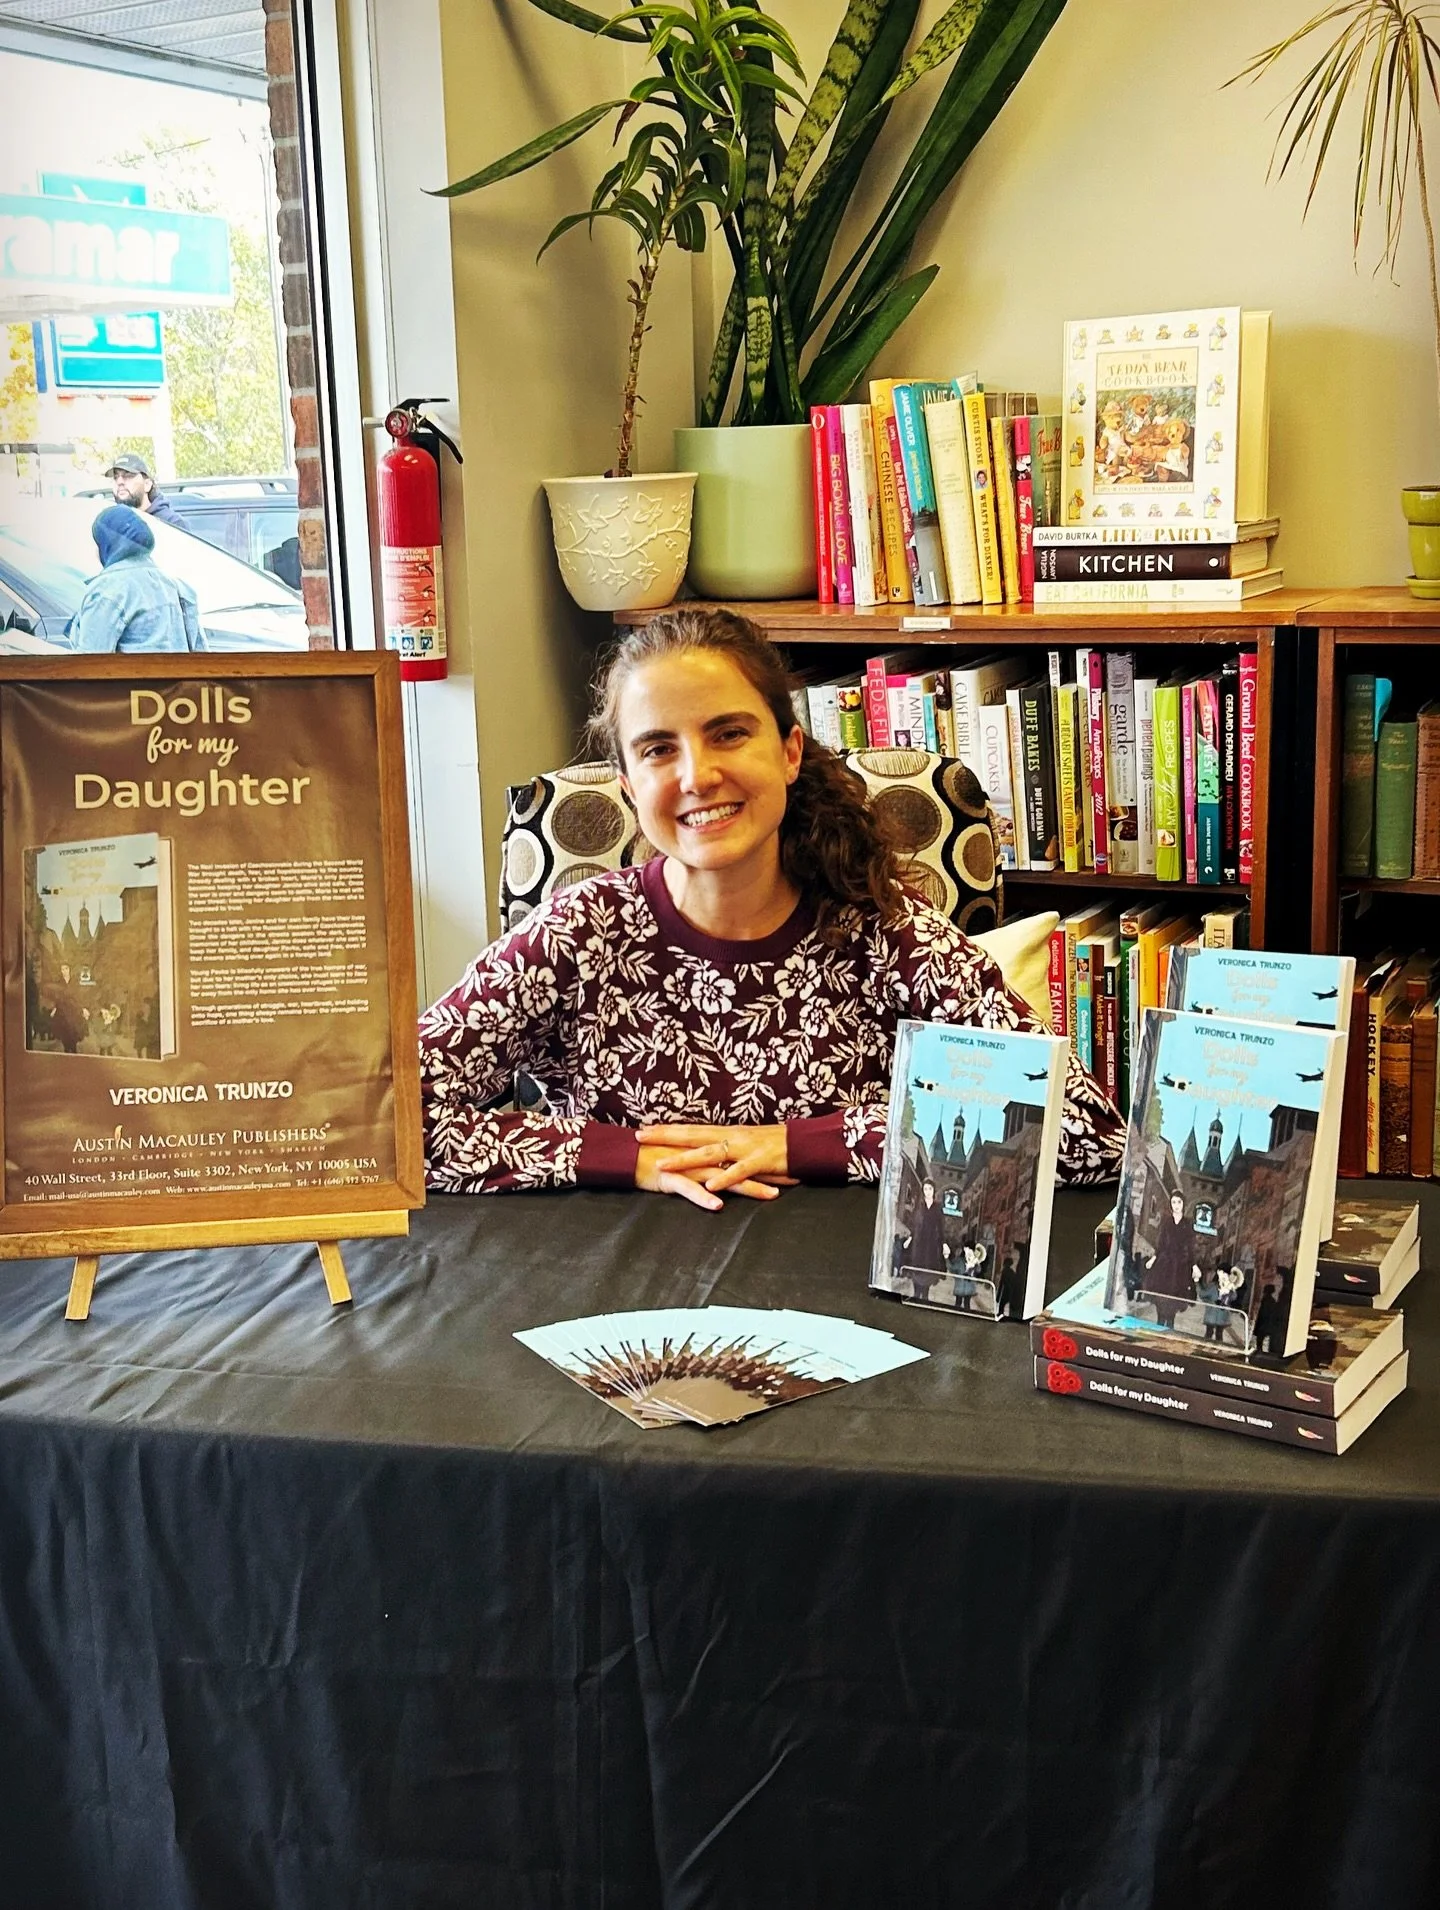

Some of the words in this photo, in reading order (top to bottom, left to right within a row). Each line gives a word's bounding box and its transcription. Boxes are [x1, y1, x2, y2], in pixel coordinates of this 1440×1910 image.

[1107, 362, 1149, 377] TEDDY
[1154, 360, 1187, 373] BEAR
[900, 390, 912, 416] JAMIE
[971, 401, 982, 434] CURTIS
[904, 416, 916, 446] OLIVER
[830, 454, 843, 478] BIG
[974, 436, 984, 465] STONE
[880, 451, 894, 504] CHINESE
[832, 479, 846, 518] BOWL
[979, 494, 989, 526] WHAT'S
[835, 528, 848, 565] LOVE
[884, 508, 898, 557] RECIPES
[982, 528, 991, 545] FOR
[1038, 532, 1063, 541] DAVID
[1065, 531, 1098, 540] BURTKA
[1102, 528, 1142, 543] LIFE
[1154, 527, 1213, 542] PARTY
[984, 546, 994, 581] DINNER?
[1079, 554, 1174, 574] KITCHEN
[1045, 585, 1068, 601] EAT
[130, 687, 252, 725] Dolls
[954, 682, 969, 717] CAKE
[1225, 694, 1233, 731] GERARD
[1241, 678, 1256, 728] Ground
[1025, 700, 1038, 732] DUFF
[1109, 703, 1131, 756] garde
[1203, 705, 1214, 732] EAST
[147, 726, 192, 763] for
[197, 737, 240, 767] my
[957, 721, 971, 757] BIBLE
[1027, 734, 1040, 771] BAKES
[1164, 719, 1176, 768] RECIPES
[1241, 732, 1256, 761] Beef
[986, 725, 1000, 793] CUPCAKES
[1062, 757, 1073, 785] SWEETS
[1203, 743, 1214, 775] WEST
[1225, 733, 1234, 782] DEPARDIEU
[74, 769, 310, 817] Daughter
[1034, 787, 1043, 806] DUFF
[1063, 787, 1074, 810] CANDY
[1095, 792, 1104, 816] 2012
[1242, 763, 1253, 831] COOKBOOK
[1035, 808, 1045, 841] GOLDMAN
[1166, 808, 1176, 826] MY
[1051, 939, 1061, 978] delicious.
[1068, 933, 1077, 962] KATZEN
[1217, 958, 1257, 968] VERONICA
[1259, 960, 1292, 971] TRUNZO
[1050, 981, 1063, 1033] FAKING
[1096, 994, 1104, 1014] Make
[1069, 994, 1078, 1049] MOOSEWOOD
[1194, 1025, 1237, 1041] VERONICA
[1239, 1032, 1275, 1047] TRUNZO
[109, 1084, 209, 1106] VERONICA
[215, 1080, 293, 1101] TRUNZO
[24, 1175, 40, 1186] 40
[41, 1173, 66, 1185] Wall
[68, 1172, 106, 1184] Street,
[109, 1169, 135, 1181] 33rd
[138, 1169, 171, 1181] Floor,
[173, 1167, 201, 1179] Suite
[205, 1165, 236, 1178] 3302,
[238, 1163, 263, 1175] New
[264, 1161, 294, 1174] York,
[296, 1161, 314, 1172] NY
[318, 1158, 350, 1170] 10005
[353, 1157, 378, 1168] USA
[72, 1156, 116, 1164] LONDON
[132, 1152, 194, 1162] CAMBRIDGE
[1085, 1345, 1109, 1361] Dolls
[1110, 1350, 1124, 1363] for
[1125, 1355, 1140, 1367] my
[1140, 1357, 1185, 1376] Daughter
[1089, 1380, 1113, 1394] Dolls
[1113, 1385, 1128, 1398] for
[1128, 1390, 1144, 1402] my
[1144, 1391, 1189, 1411] Daughter
